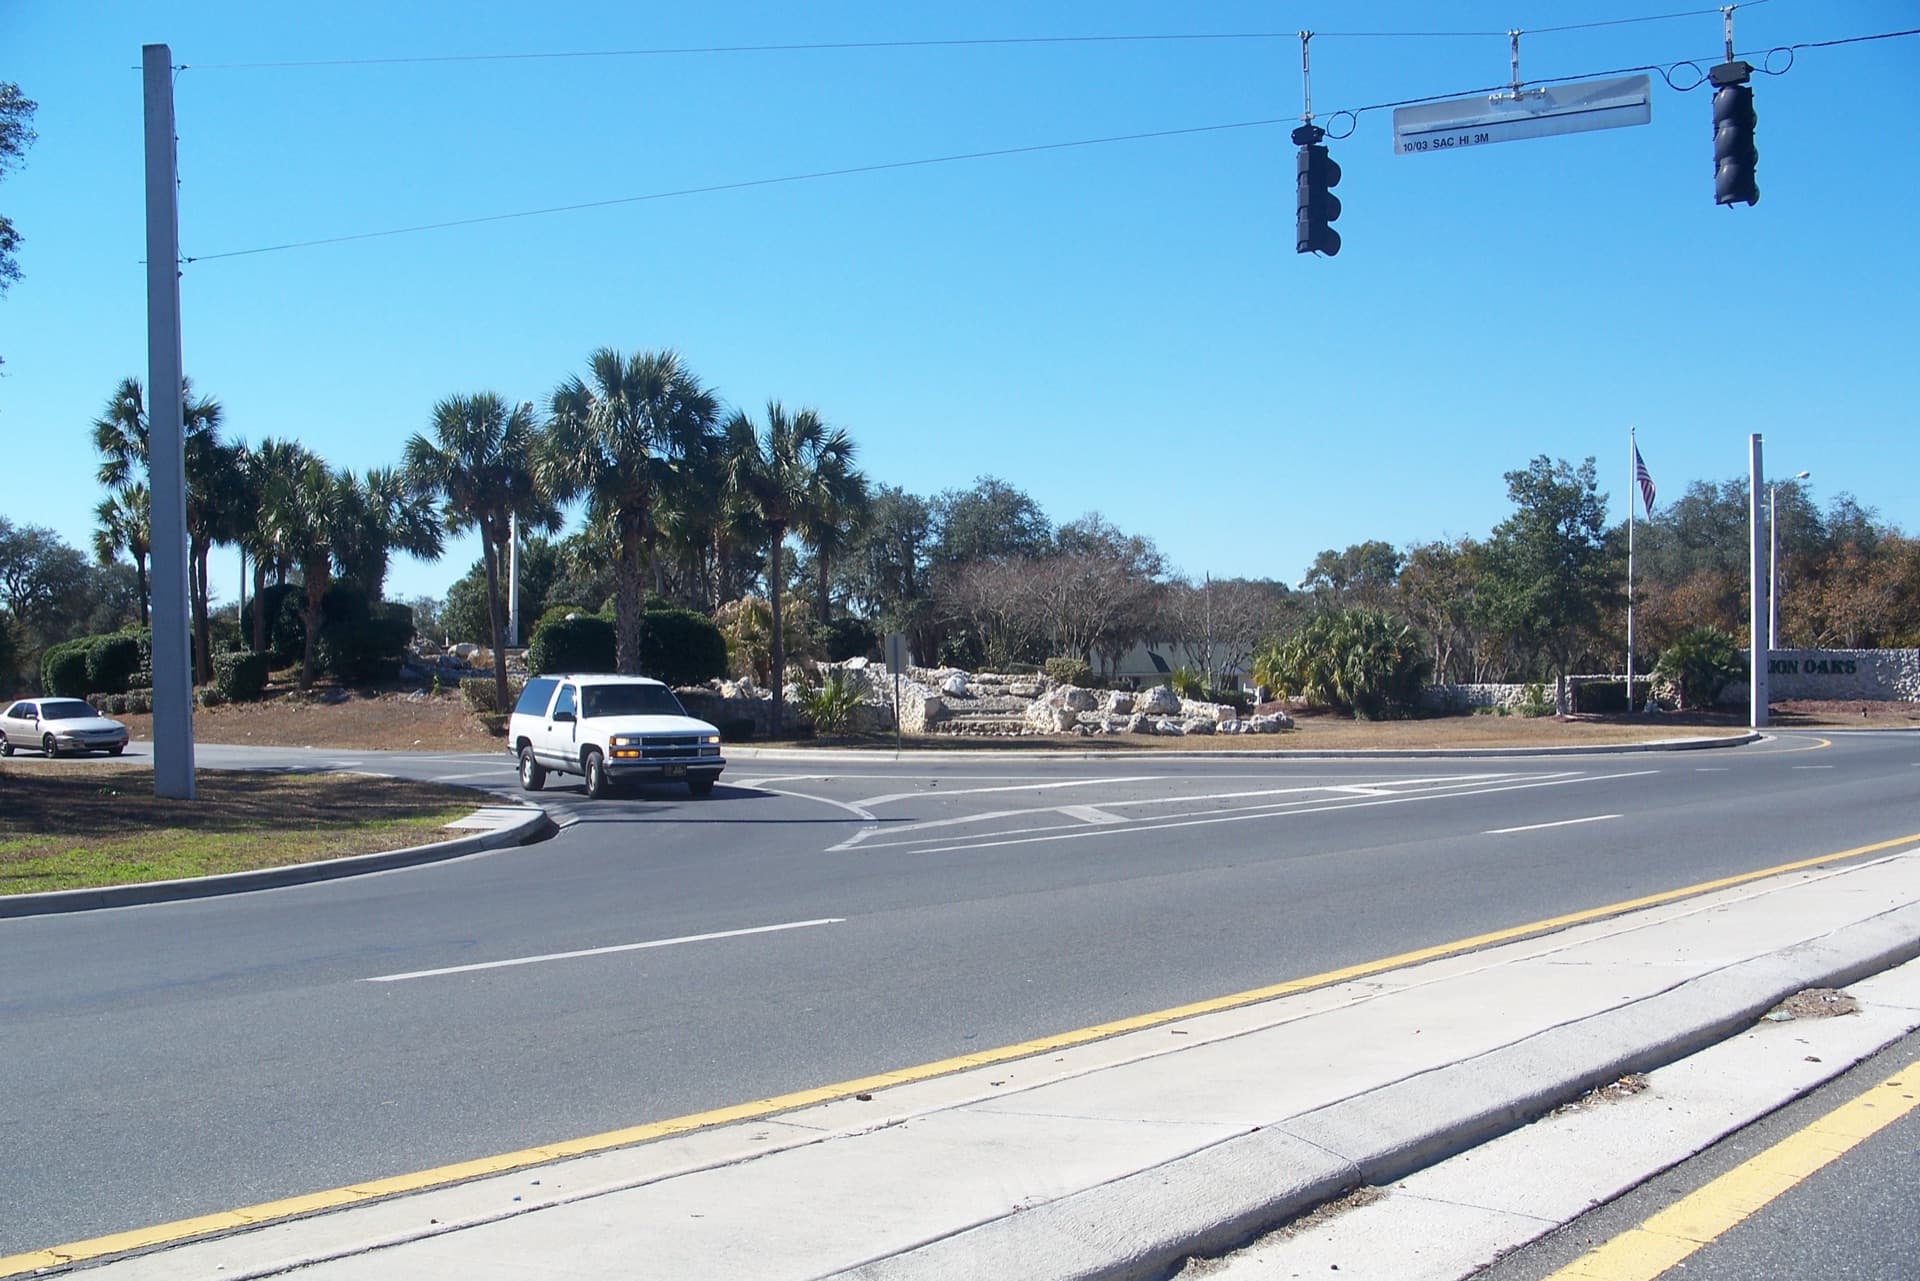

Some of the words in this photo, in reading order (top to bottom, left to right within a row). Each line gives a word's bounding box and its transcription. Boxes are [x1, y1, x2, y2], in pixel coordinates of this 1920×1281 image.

[1403, 140, 1428, 153] 10/03
[1432, 137, 1455, 149] SAC
[1459, 135, 1469, 145] HI
[1474, 133, 1489, 144] 3M
[1768, 659, 1799, 674] ION
[1804, 659, 1857, 674] OAKS
